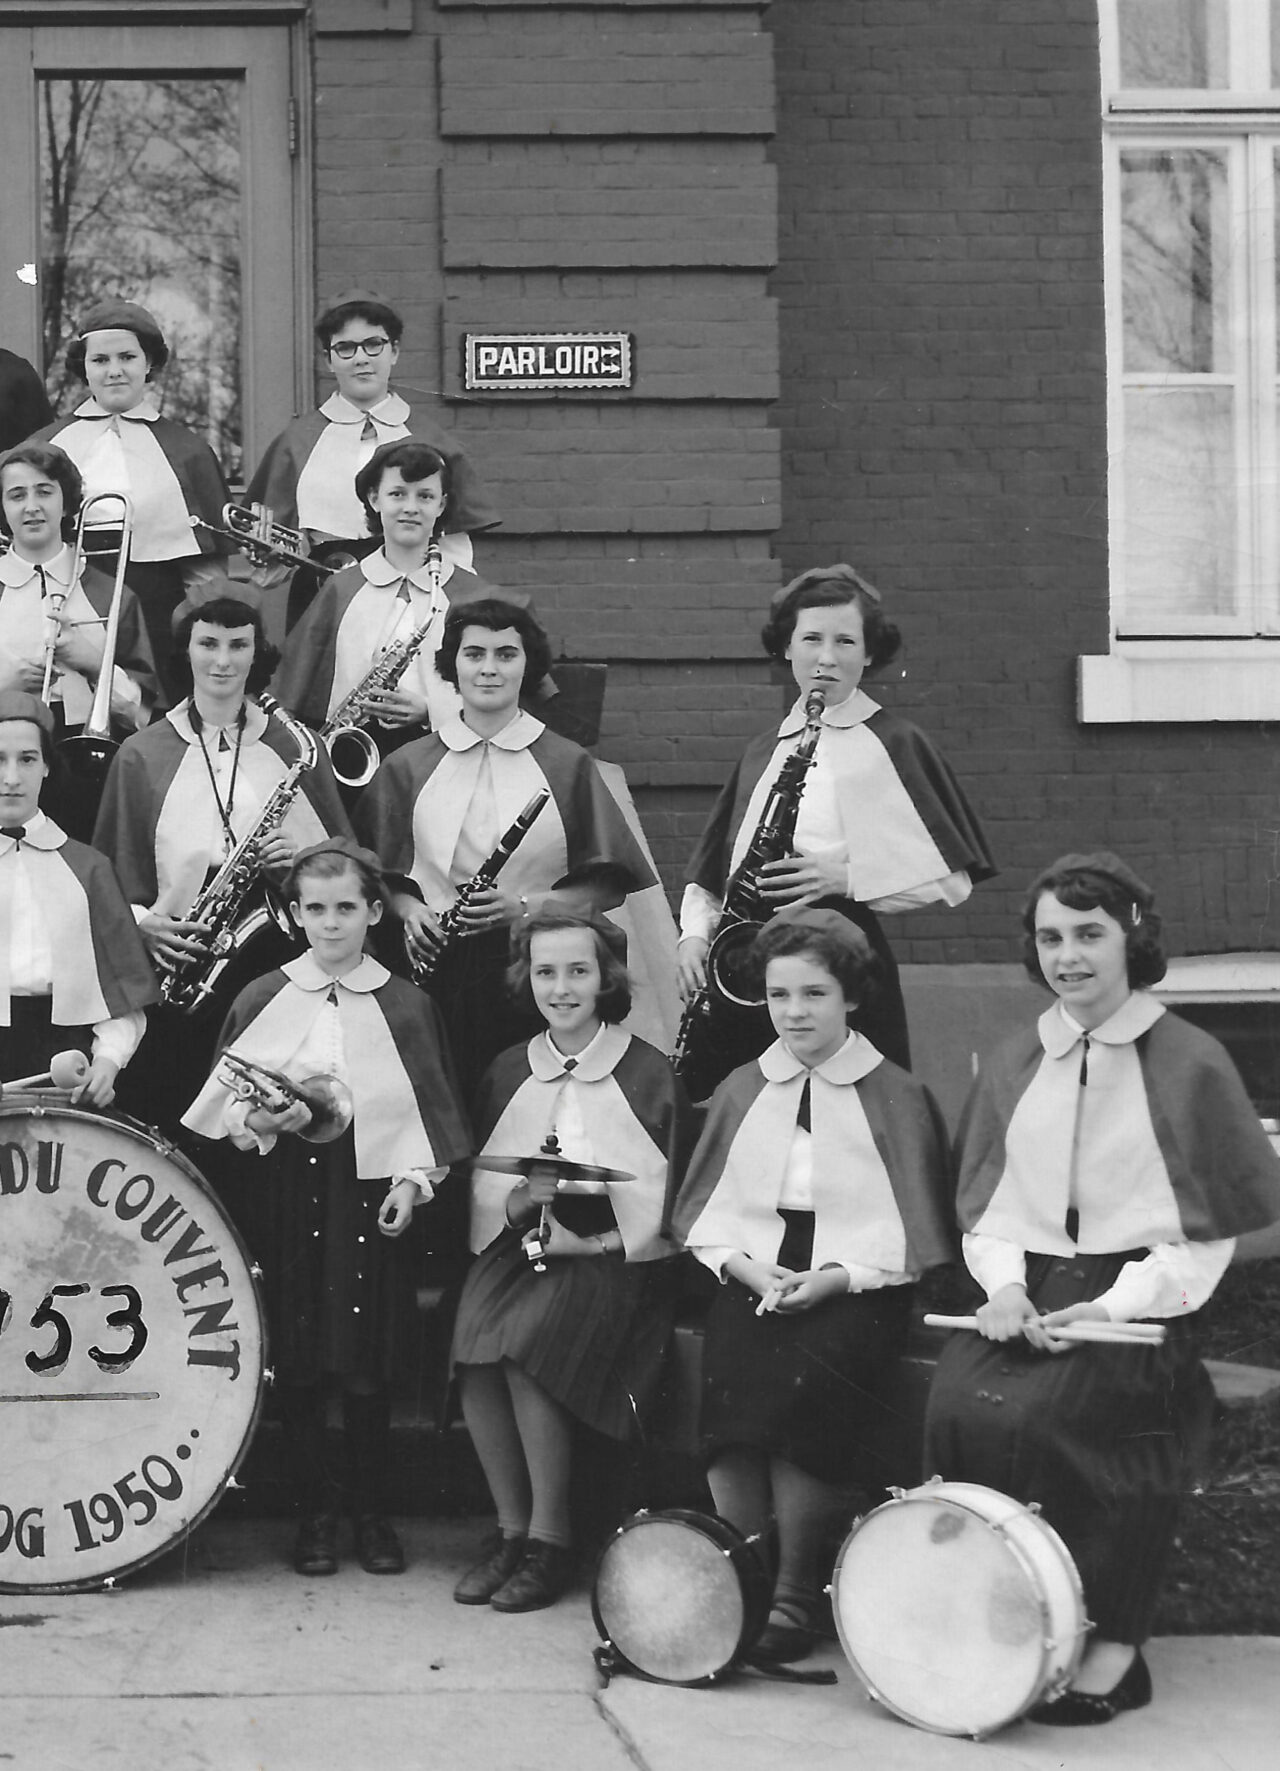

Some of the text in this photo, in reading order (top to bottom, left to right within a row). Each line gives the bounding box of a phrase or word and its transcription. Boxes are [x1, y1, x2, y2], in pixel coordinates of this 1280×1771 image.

[479, 345, 600, 376] PARLOIR
[86, 1158, 242, 1383] COUVENT
[63, 1454, 184, 1553] 1950
